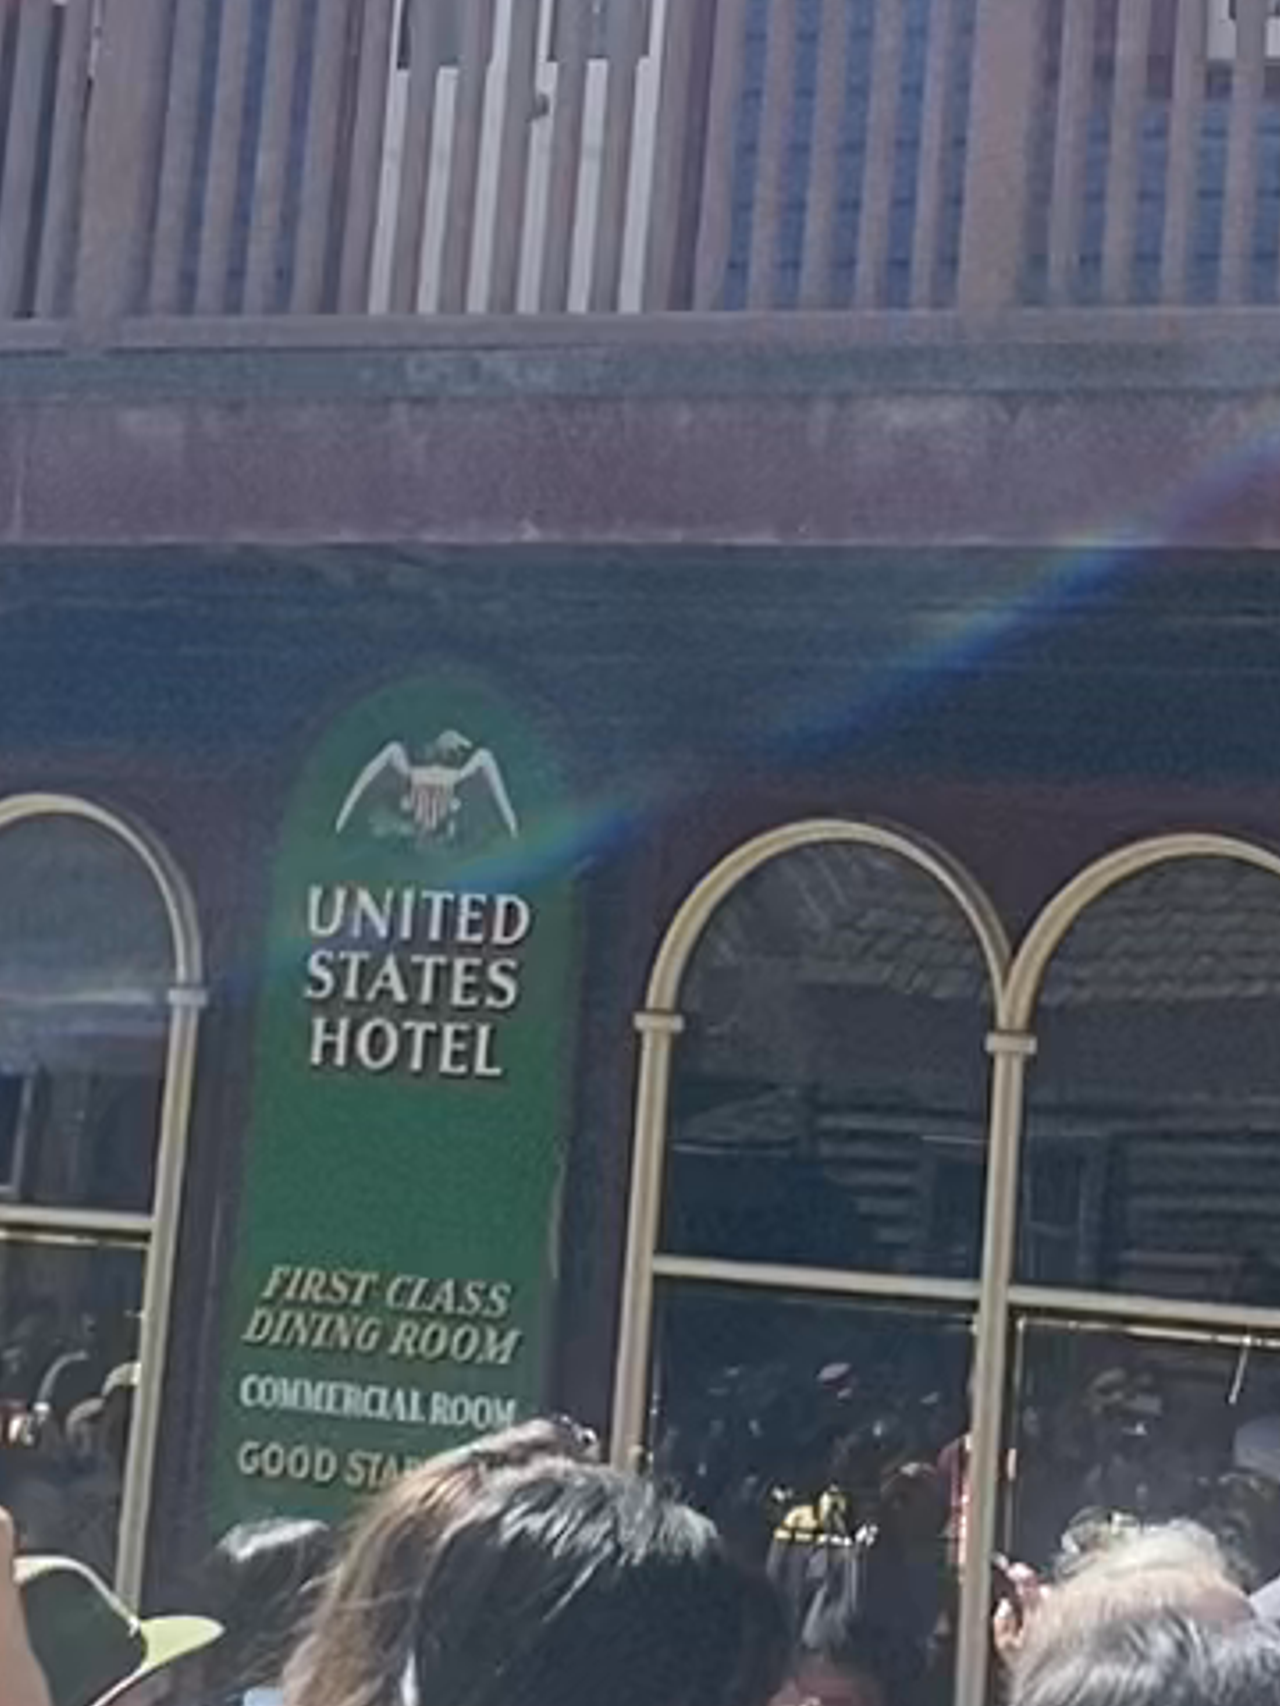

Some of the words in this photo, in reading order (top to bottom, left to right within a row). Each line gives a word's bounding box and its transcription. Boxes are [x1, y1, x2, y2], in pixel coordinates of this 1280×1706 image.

[307, 885, 530, 944] UNITED
[305, 950, 518, 1008] STATES
[311, 1018, 502, 1075] HOTEL
[261, 1265, 378, 1306] FIRST
[385, 1273, 511, 1317] CLASS
[241, 1308, 383, 1351] DINING
[389, 1322, 521, 1364] ROOM
[239, 1373, 426, 1422] COMMERCIAL
[429, 1390, 516, 1429] ROOM
[238, 1441, 337, 1482] GOOD
